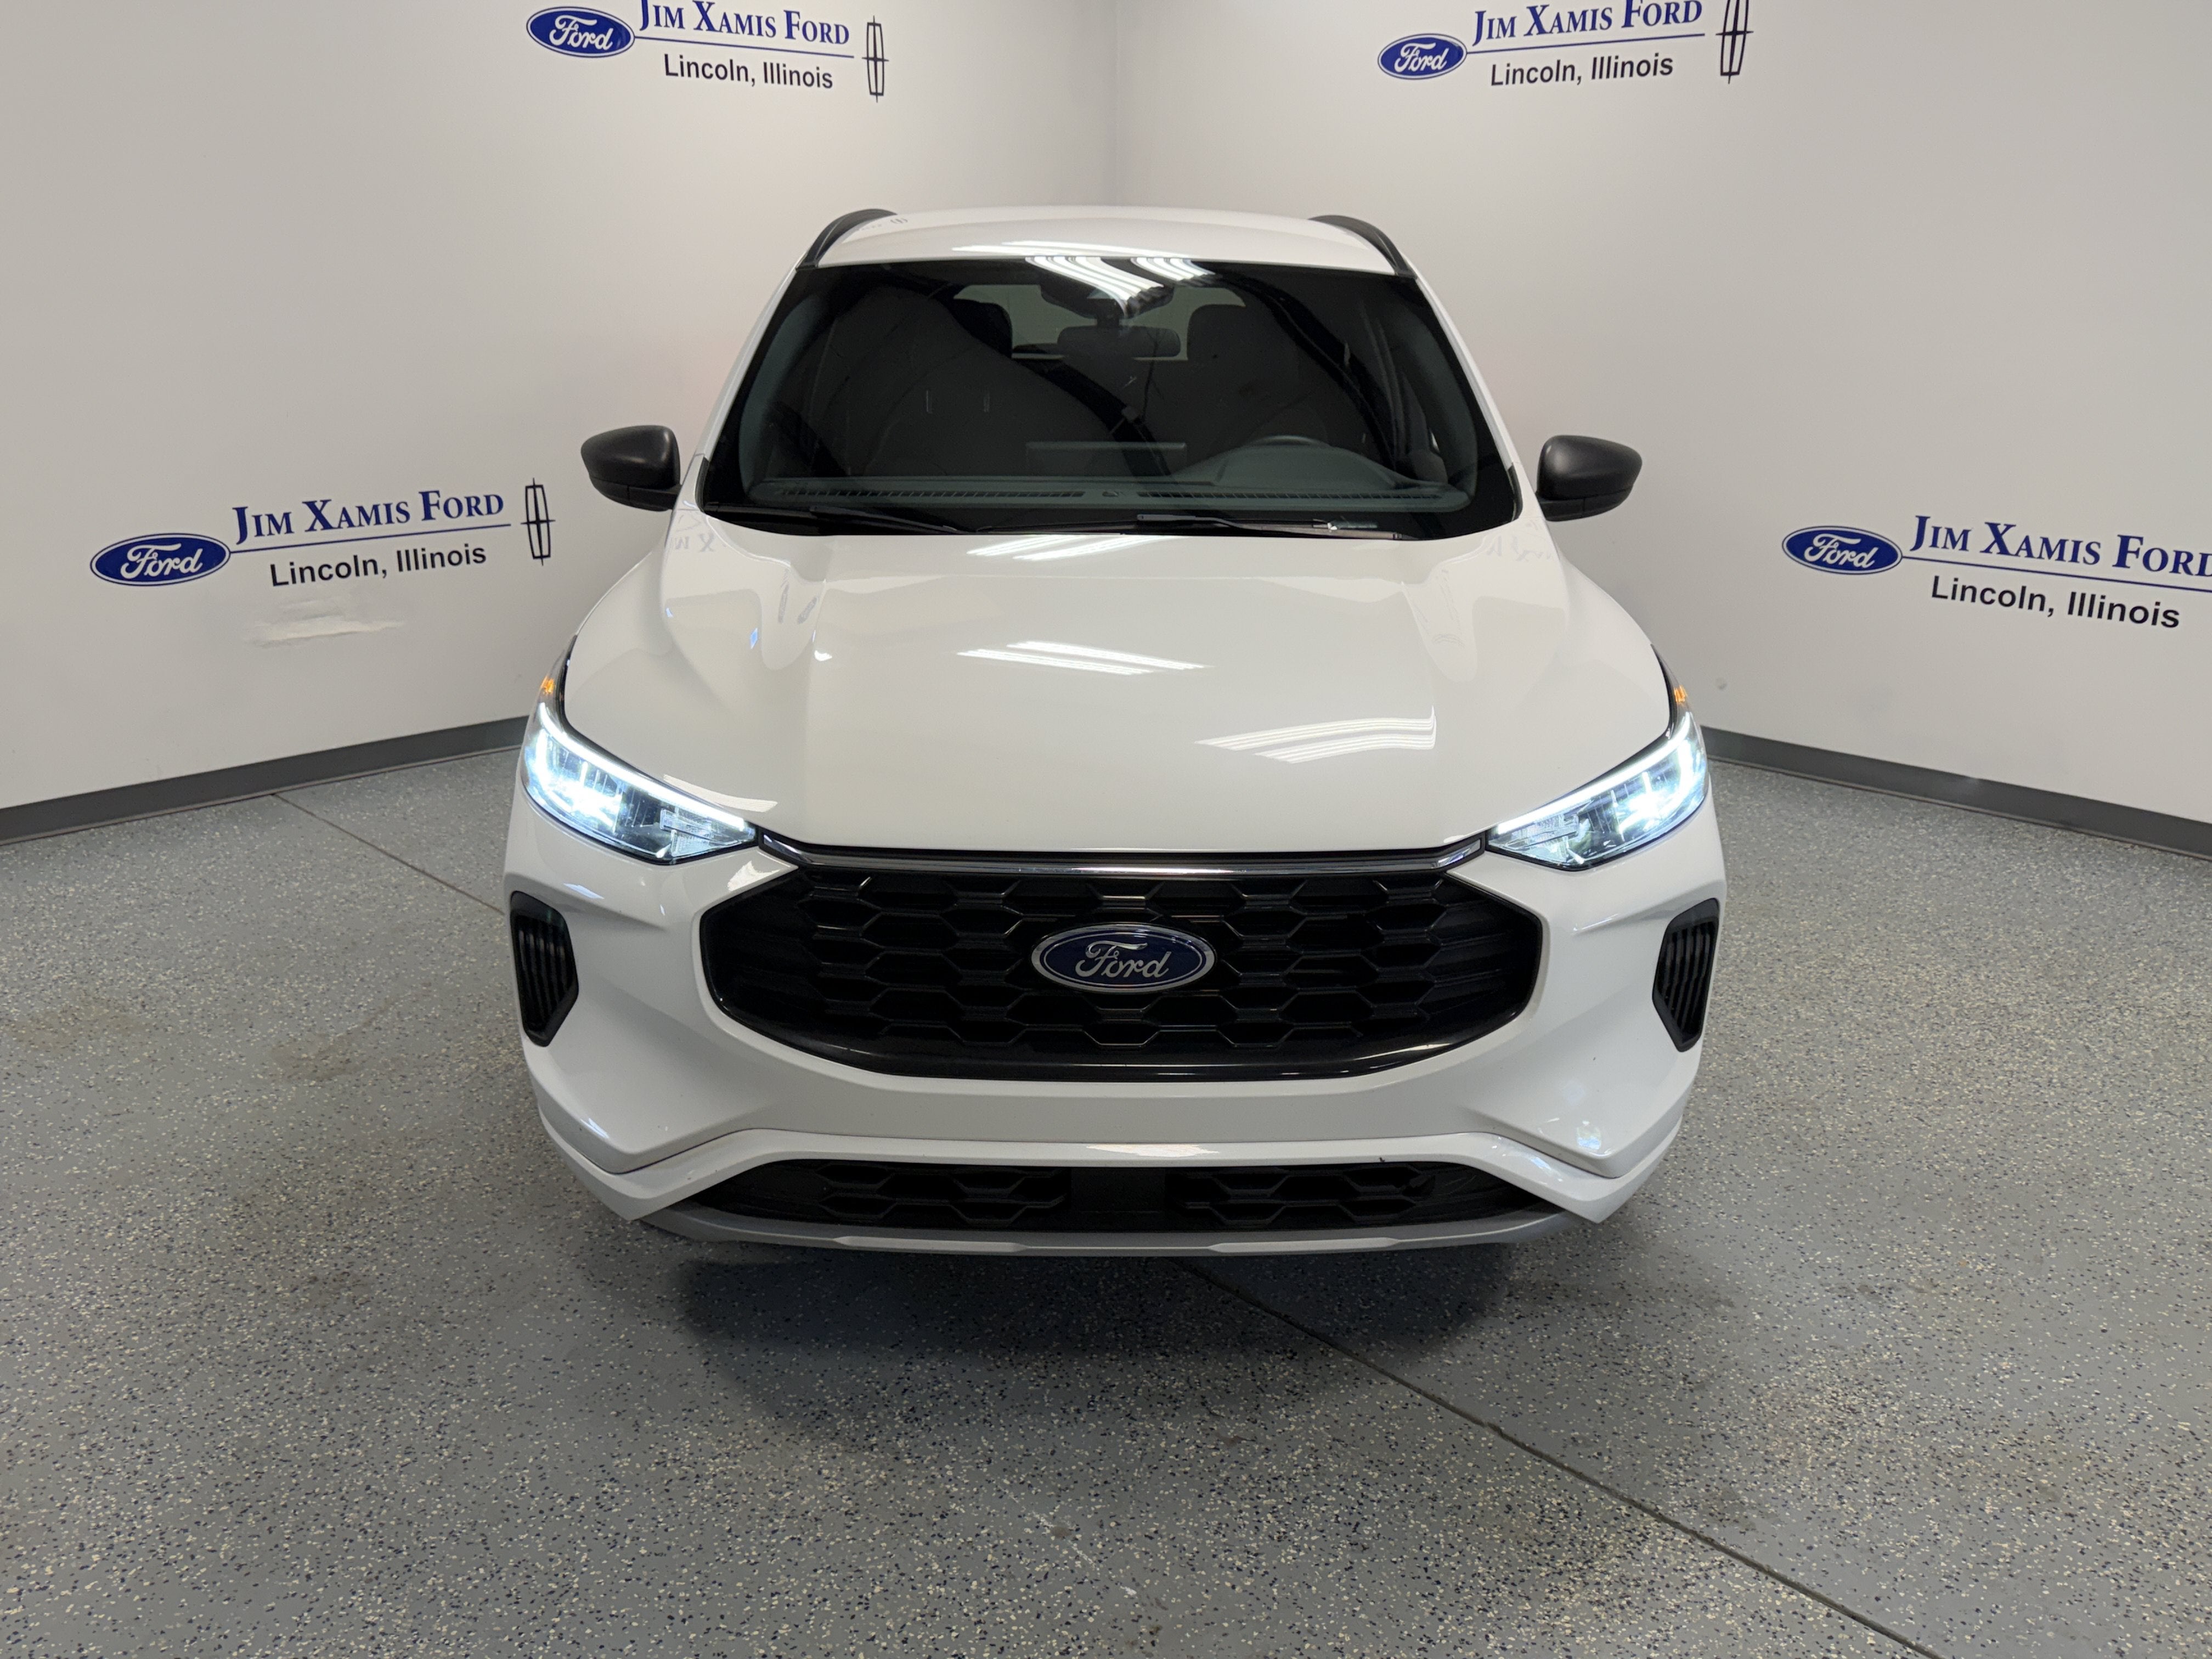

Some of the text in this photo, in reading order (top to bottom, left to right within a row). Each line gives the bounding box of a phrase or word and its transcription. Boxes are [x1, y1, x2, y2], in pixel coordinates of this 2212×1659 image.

[549, 15, 613, 50] Ford
[640, 0, 849, 44] JIM XAMIS FORD
[1472, 0, 1702, 46] JIM XAMIS FORD
[664, 54, 833, 88] Lincoln, Illinois
[1395, 43, 1448, 72] Ford
[1491, 53, 1673, 86] Lincoln, Illinois
[233, 490, 504, 545] JIM XAMIS FORD
[121, 544, 202, 579] Ford
[270, 544, 487, 587] Lincoln, Illinois
[1804, 534, 1876, 568] Ford
[1910, 516, 2212, 577] JIM XAMIS FORD
[1932, 576, 2180, 628] Lincoln, Illinois
[1075, 940, 1171, 978] Ford
